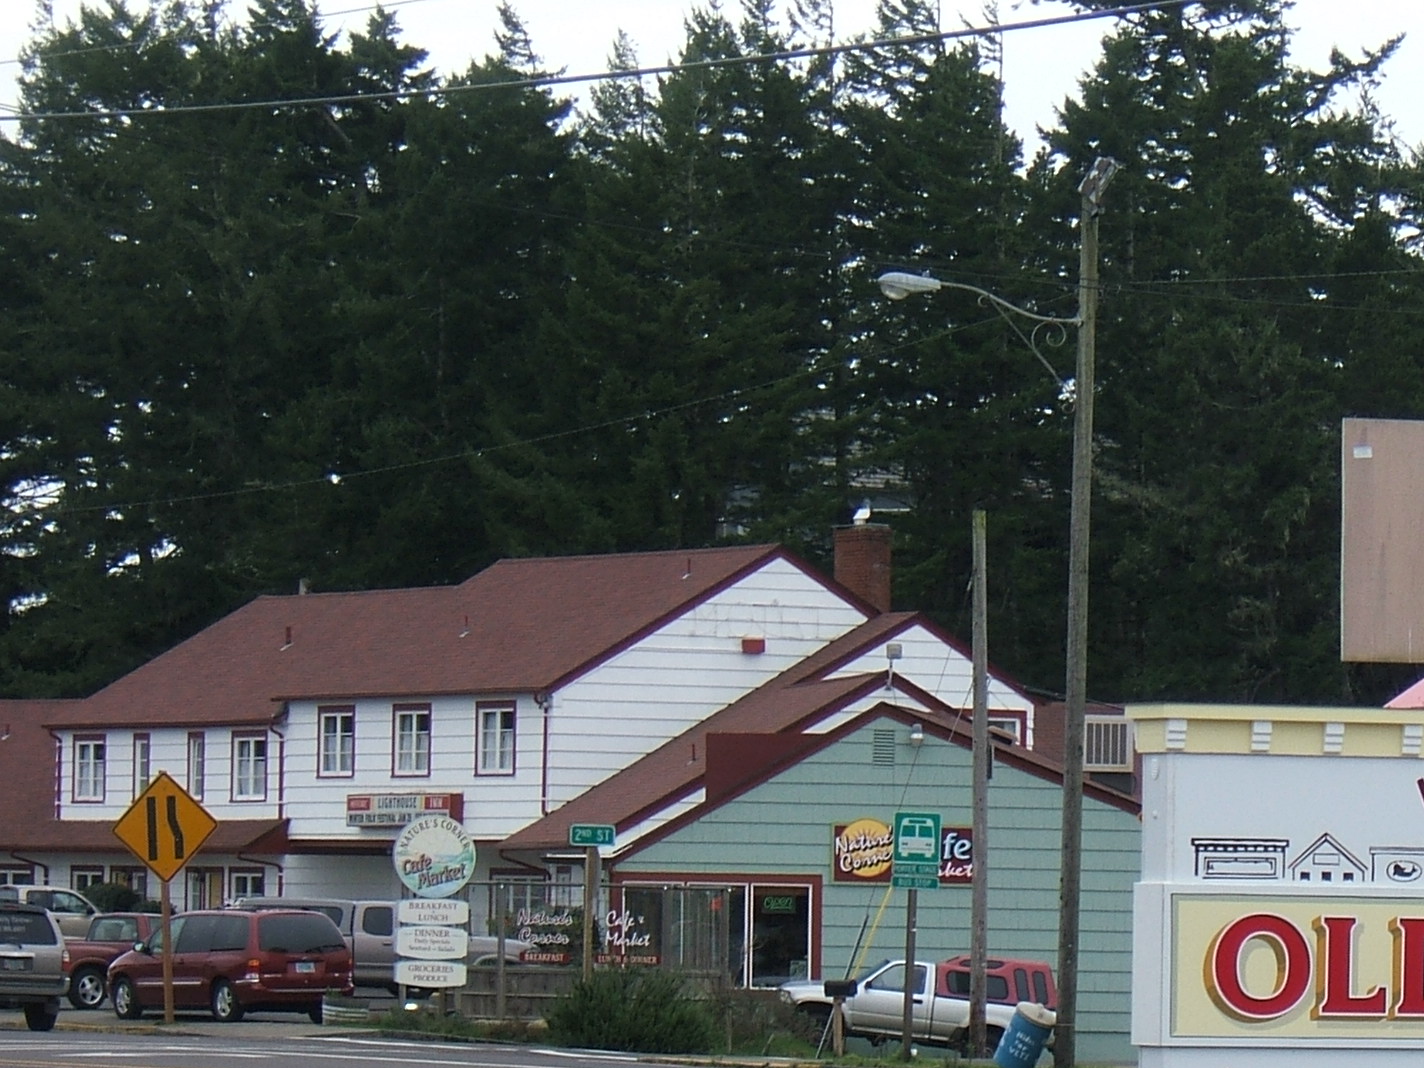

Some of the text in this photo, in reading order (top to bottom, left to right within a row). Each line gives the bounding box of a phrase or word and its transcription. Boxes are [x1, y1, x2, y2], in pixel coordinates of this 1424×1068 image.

[377, 796, 417, 809] LIGHTHOUSE
[400, 818, 471, 849] NATURE'S CORNER
[597, 829, 611, 843] ST
[835, 825, 894, 854] Nature'
[943, 832, 973, 860] fe
[402, 853, 433, 876] Cafe
[839, 850, 894, 873] Corne
[417, 863, 467, 890] Market
[408, 902, 458, 911] BREAKFAST
[418, 914, 449, 922] LUNCH
[414, 929, 451, 938] DINNER
[604, 932, 651, 948] Market
[524, 953, 565, 962] BREAKFAST
[407, 964, 455, 974] GROCERIES
[412, 974, 448, 983] PRODUCE
